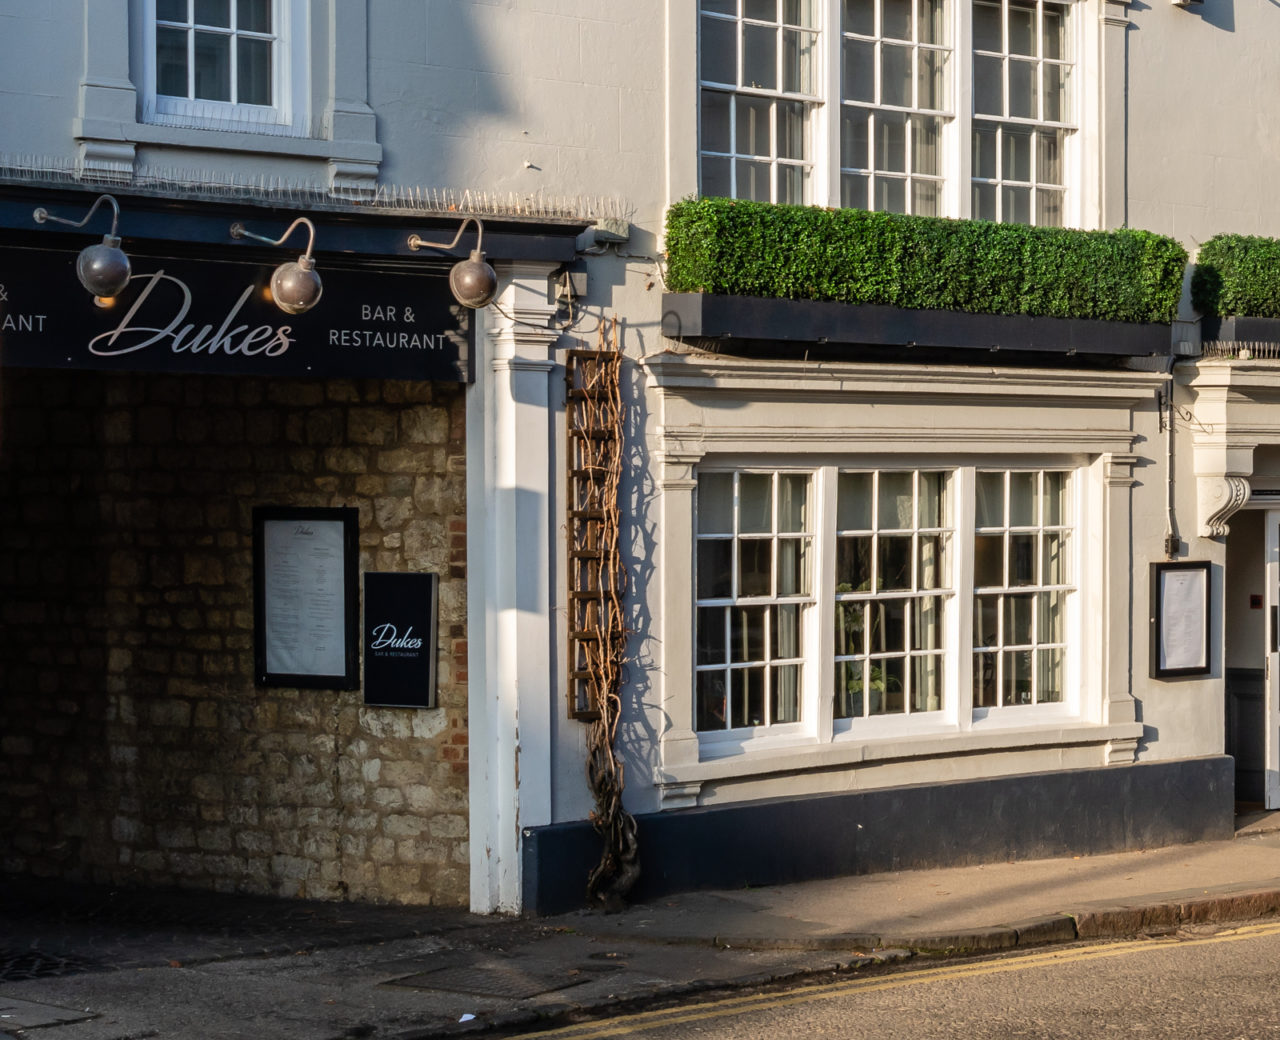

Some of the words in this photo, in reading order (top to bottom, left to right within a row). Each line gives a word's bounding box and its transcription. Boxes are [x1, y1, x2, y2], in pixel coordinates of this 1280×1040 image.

[88, 269, 297, 356] Dukes
[361, 304, 396, 322] BAR
[403, 306, 416, 323] &
[328, 329, 446, 351] RESTAURANT
[371, 623, 423, 649] Dukes
